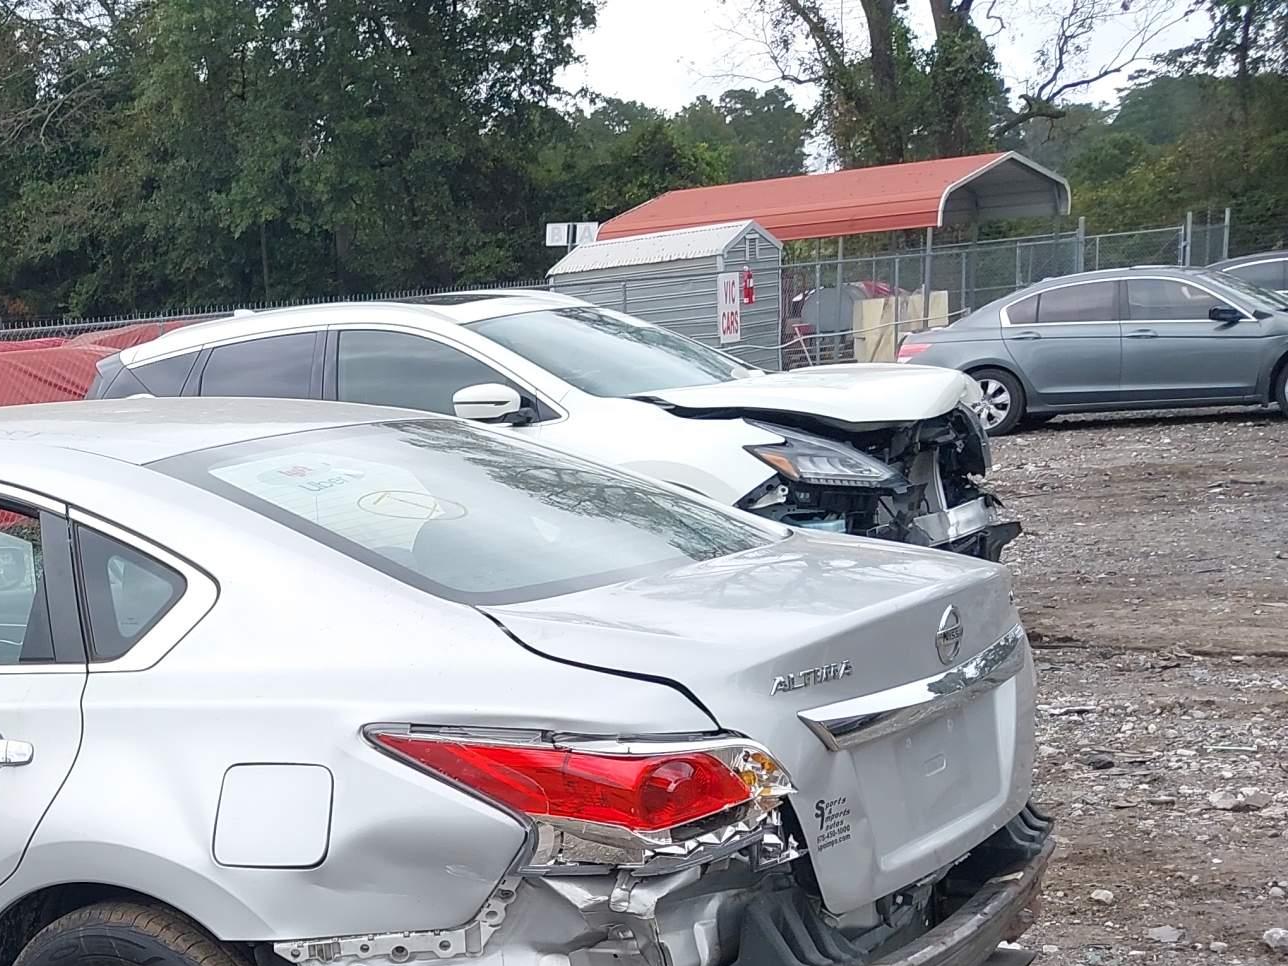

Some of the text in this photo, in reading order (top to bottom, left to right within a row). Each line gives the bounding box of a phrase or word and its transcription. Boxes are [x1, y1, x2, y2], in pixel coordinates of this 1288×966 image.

[723, 279, 736, 305] VIC
[721, 310, 739, 335] CARS
[769, 659, 853, 697] ALTIMA
[815, 797, 846, 819] Sports
